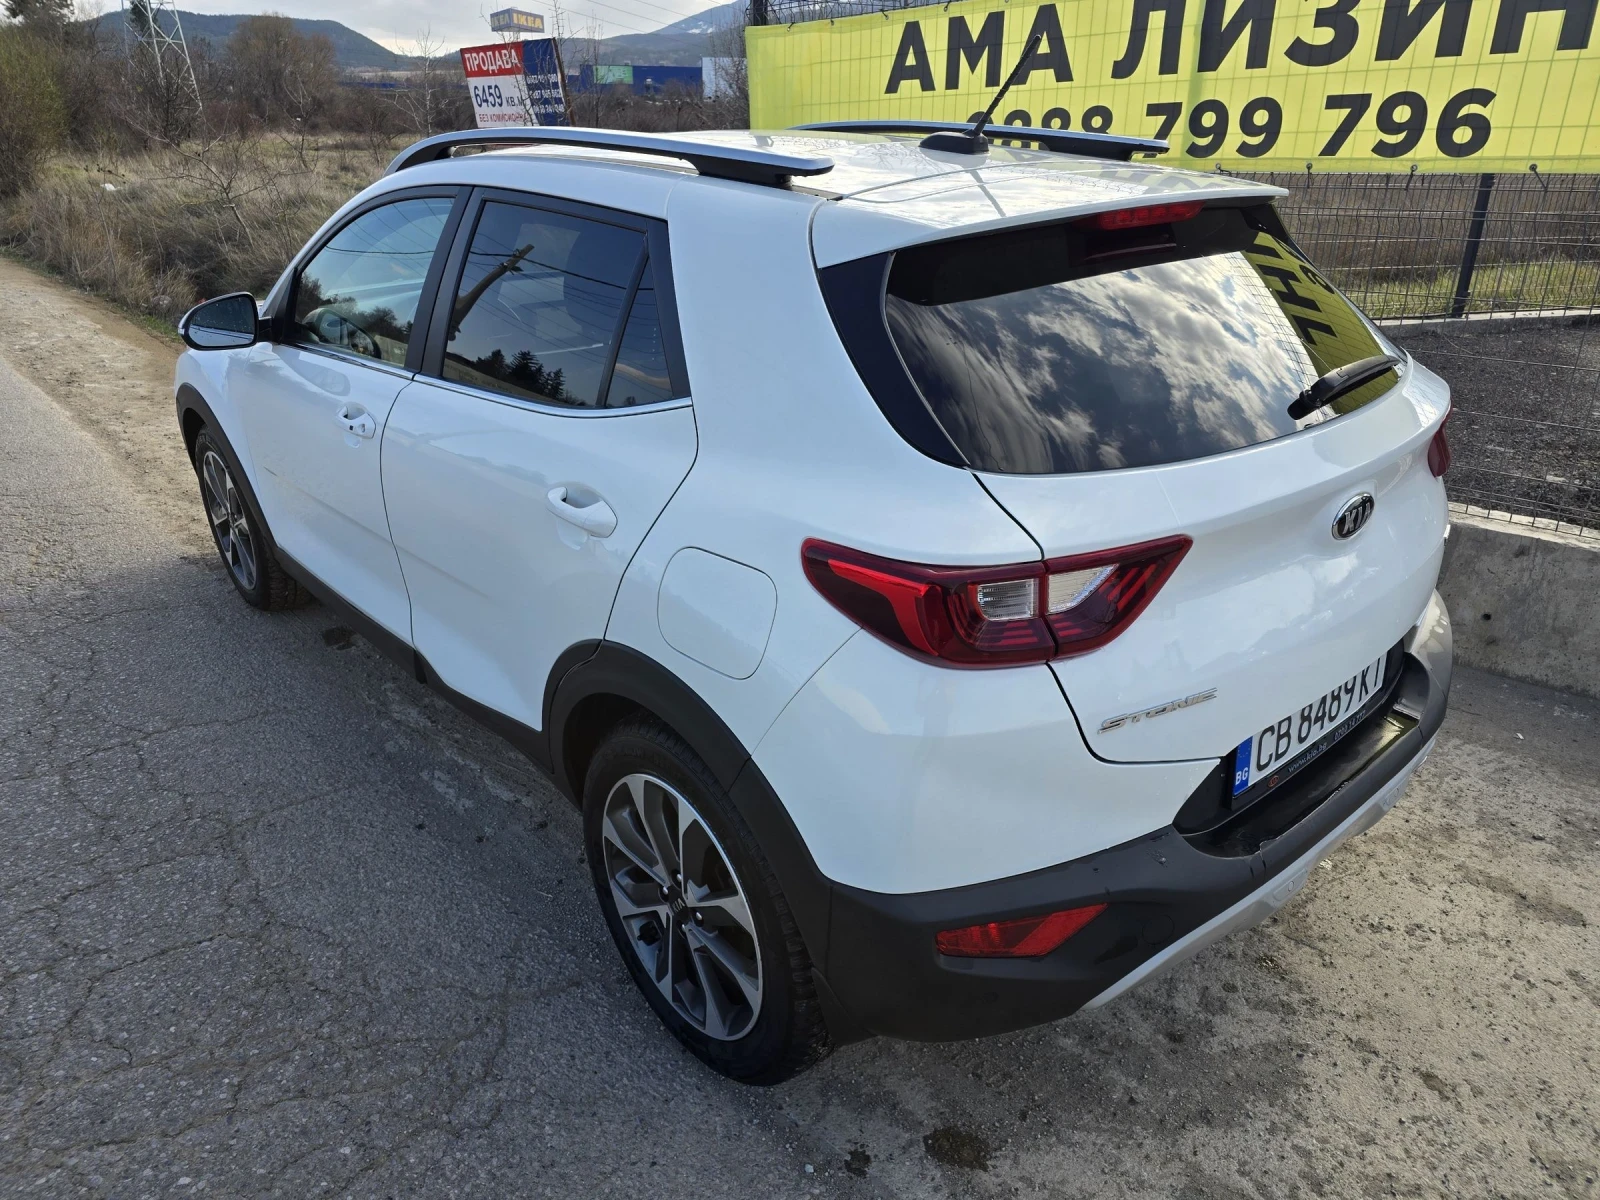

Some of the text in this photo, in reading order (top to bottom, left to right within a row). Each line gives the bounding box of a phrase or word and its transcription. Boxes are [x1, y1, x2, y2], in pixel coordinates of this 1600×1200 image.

[512, 12, 543, 29] IKEA
[465, 49, 520, 74] ПРОДАВА
[884, 3, 1074, 95] АМА
[473, 84, 504, 108] 6459
[1143, 96, 1283, 159] 799
[1317, 87, 1498, 158] 796
[1342, 502, 1371, 535] KIA
[1235, 767, 1249, 785] BG
